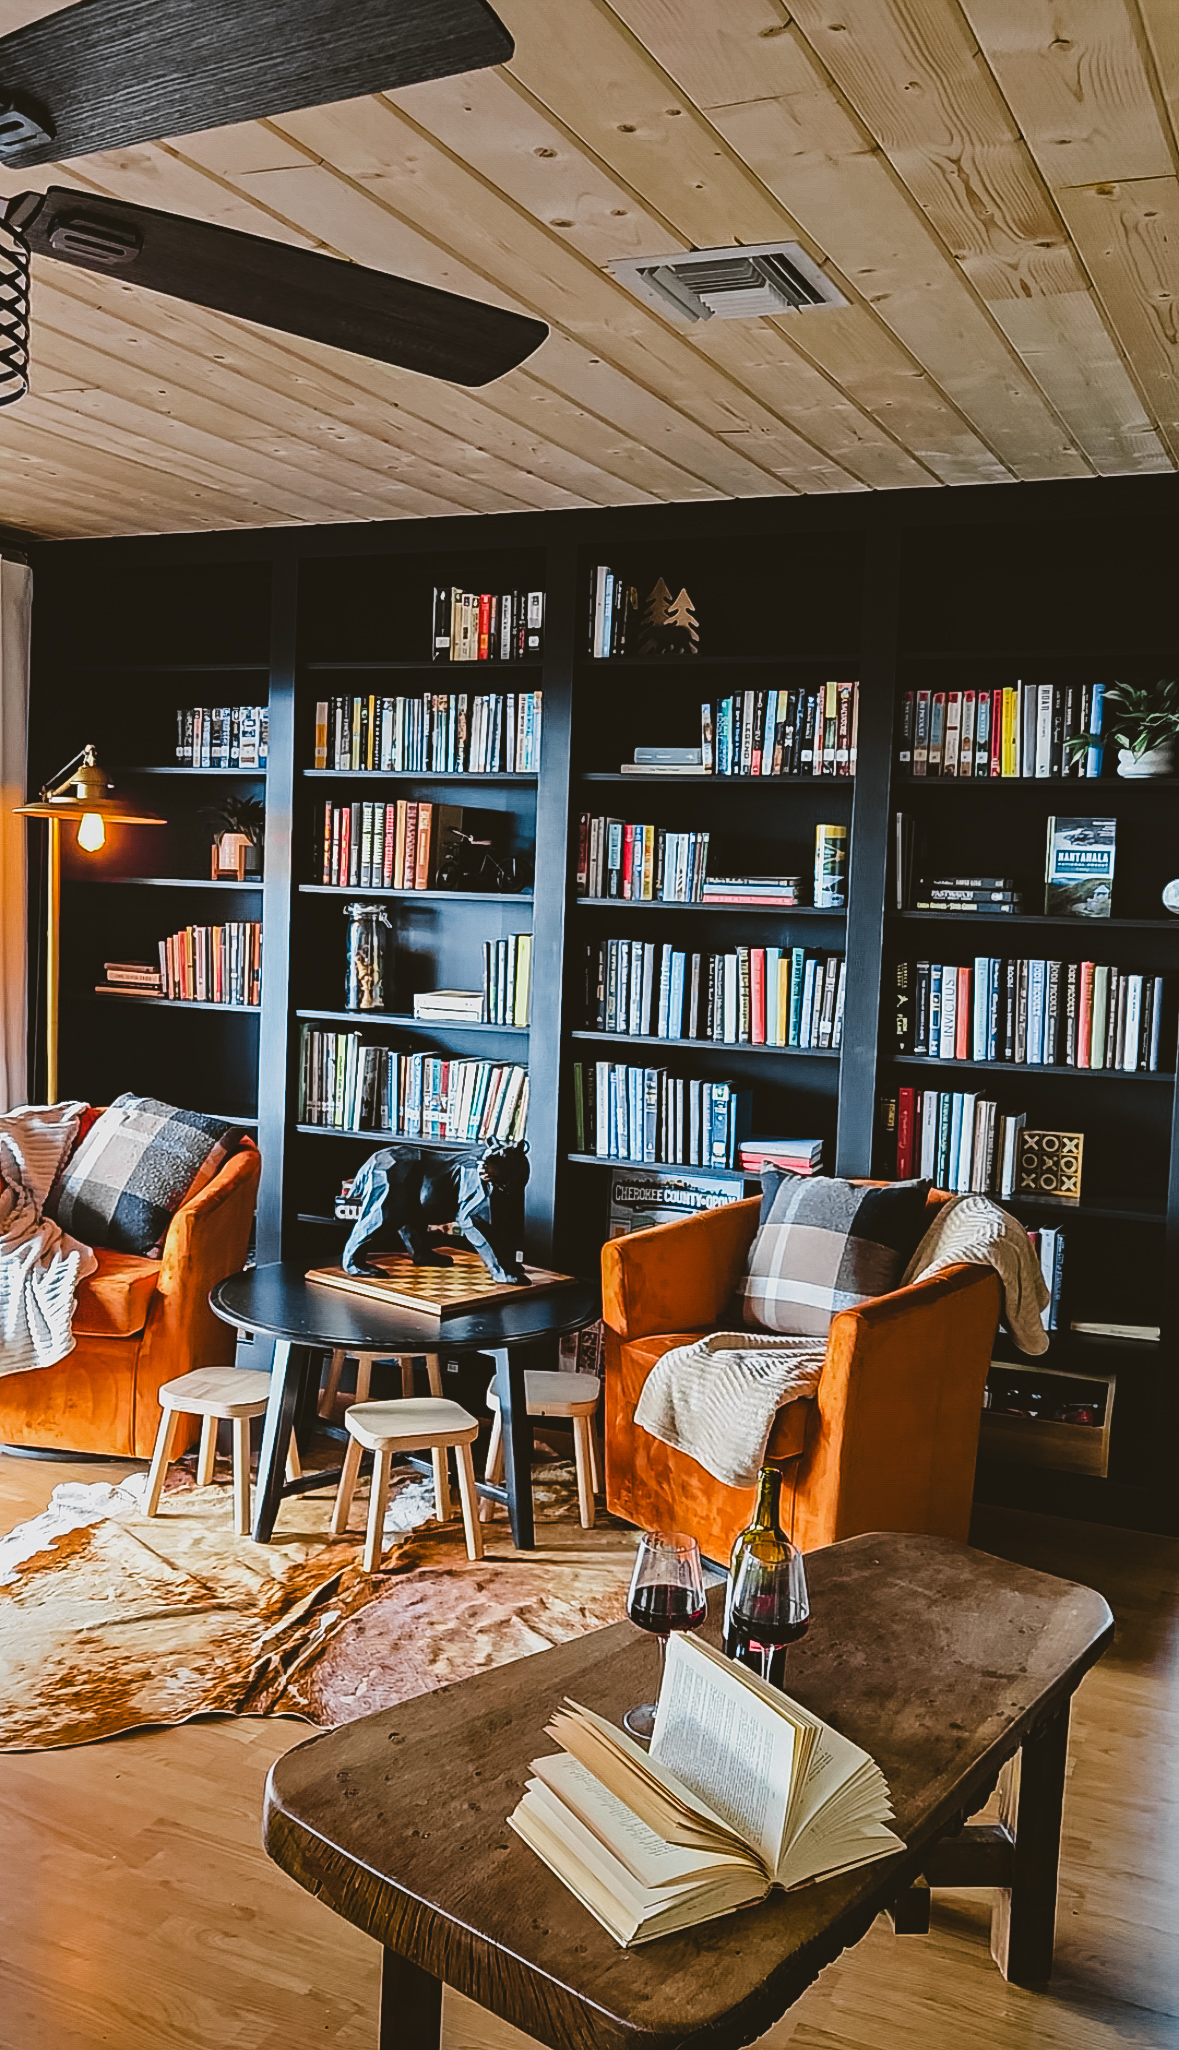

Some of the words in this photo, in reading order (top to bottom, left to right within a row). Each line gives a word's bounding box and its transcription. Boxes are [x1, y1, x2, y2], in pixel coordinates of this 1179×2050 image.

[1057, 852, 1109, 863] NANTAHALA
[943, 979, 955, 1038] INVICTUS
[615, 1184, 663, 1202] CHEROKEE
